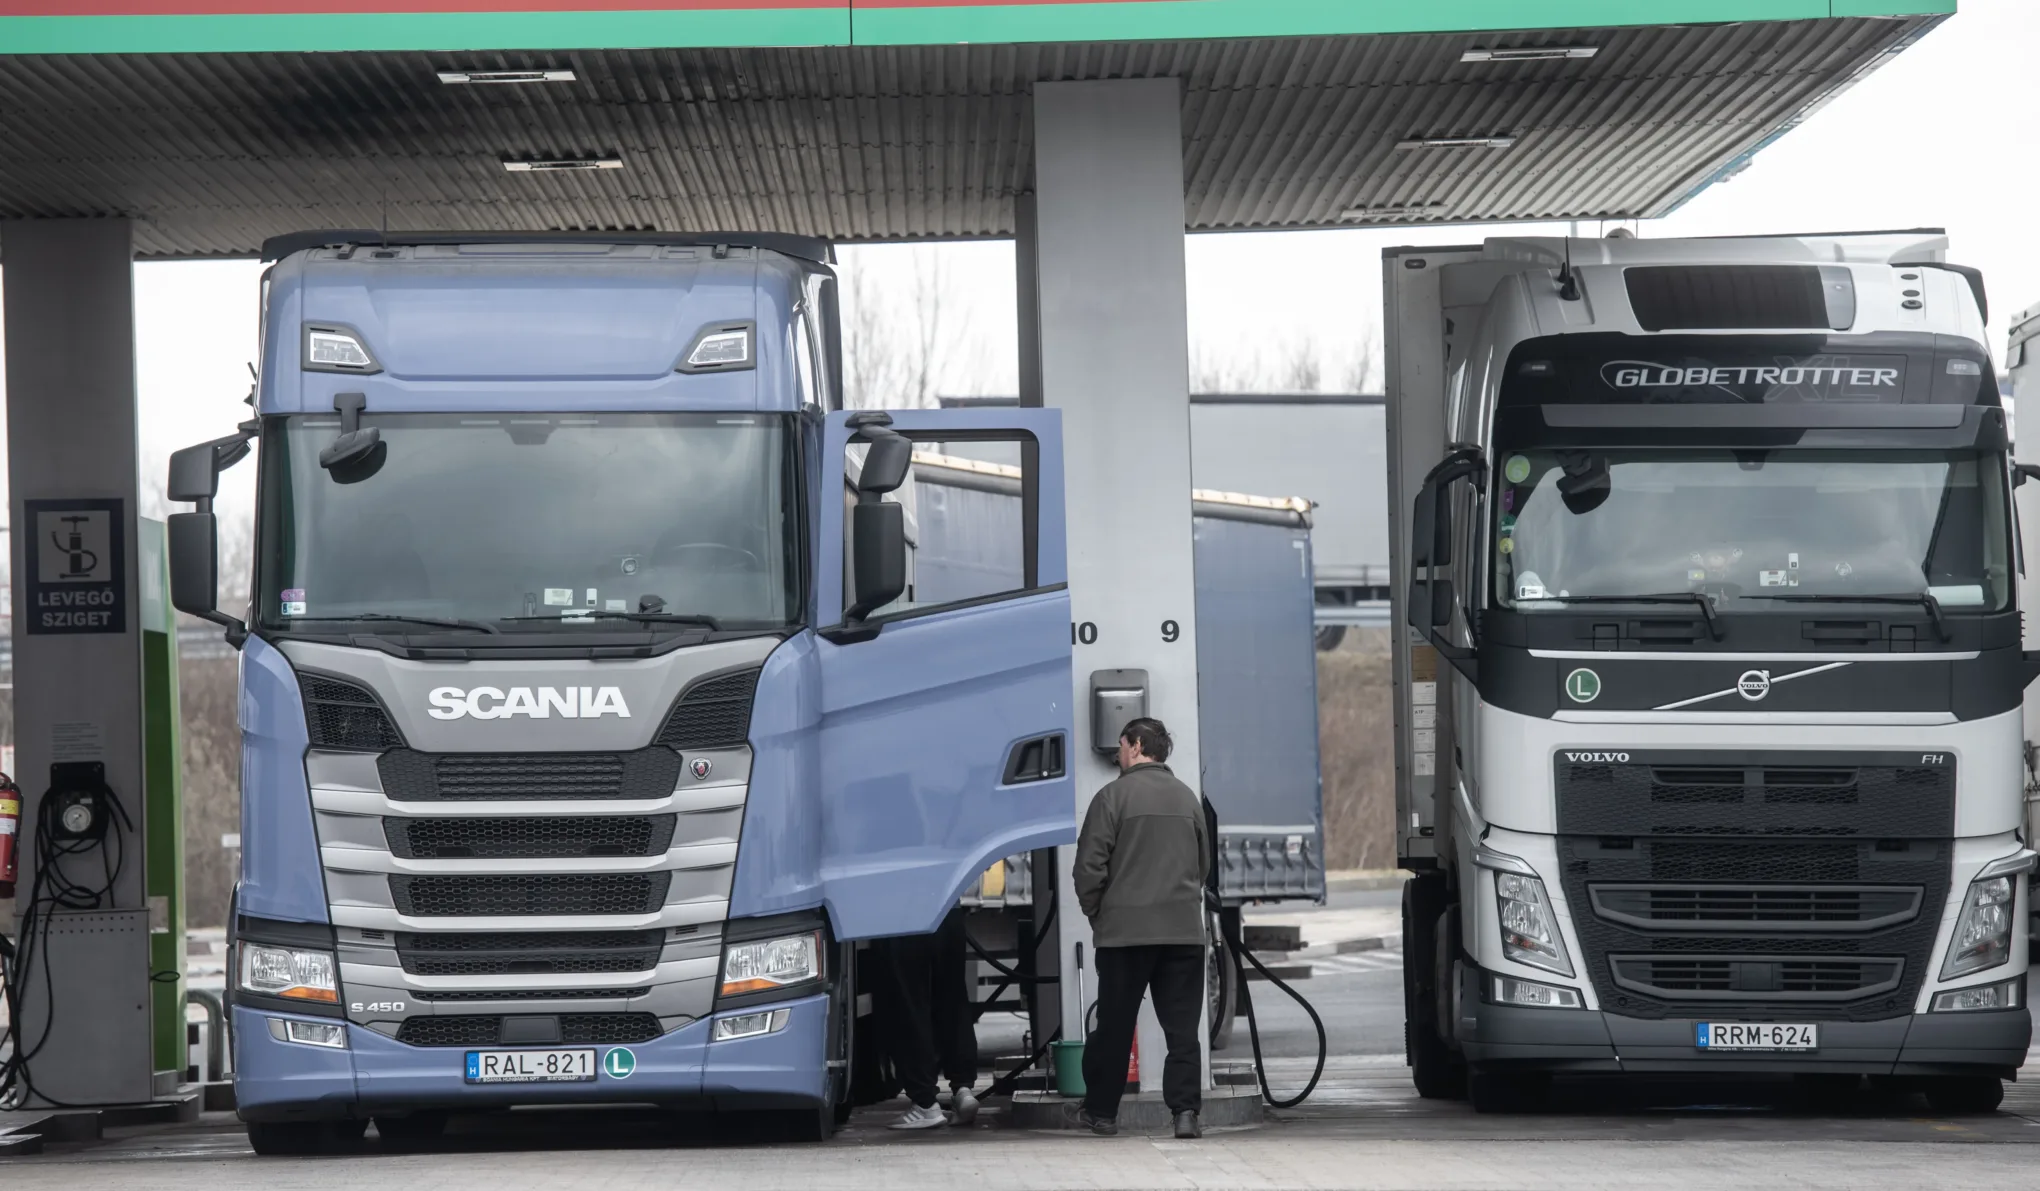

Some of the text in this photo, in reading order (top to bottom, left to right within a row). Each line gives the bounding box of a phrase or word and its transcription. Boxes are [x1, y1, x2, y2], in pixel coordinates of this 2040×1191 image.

[1615, 366, 1899, 387] GLOBETROTTER
[38, 587, 114, 607] LEVEGŐ
[42, 611, 111, 627] SZIGET
[1161, 619, 1180, 643] 9
[1577, 675, 1591, 696] L
[427, 686, 632, 720] SCANIA
[1565, 752, 1630, 763] VOLVO
[1921, 754, 1944, 765] FH
[351, 1001, 405, 1013] S 450
[1700, 1026, 1811, 1045] H RRM-624
[469, 1053, 587, 1075] H RAL-821
[612, 1052, 629, 1074] L
